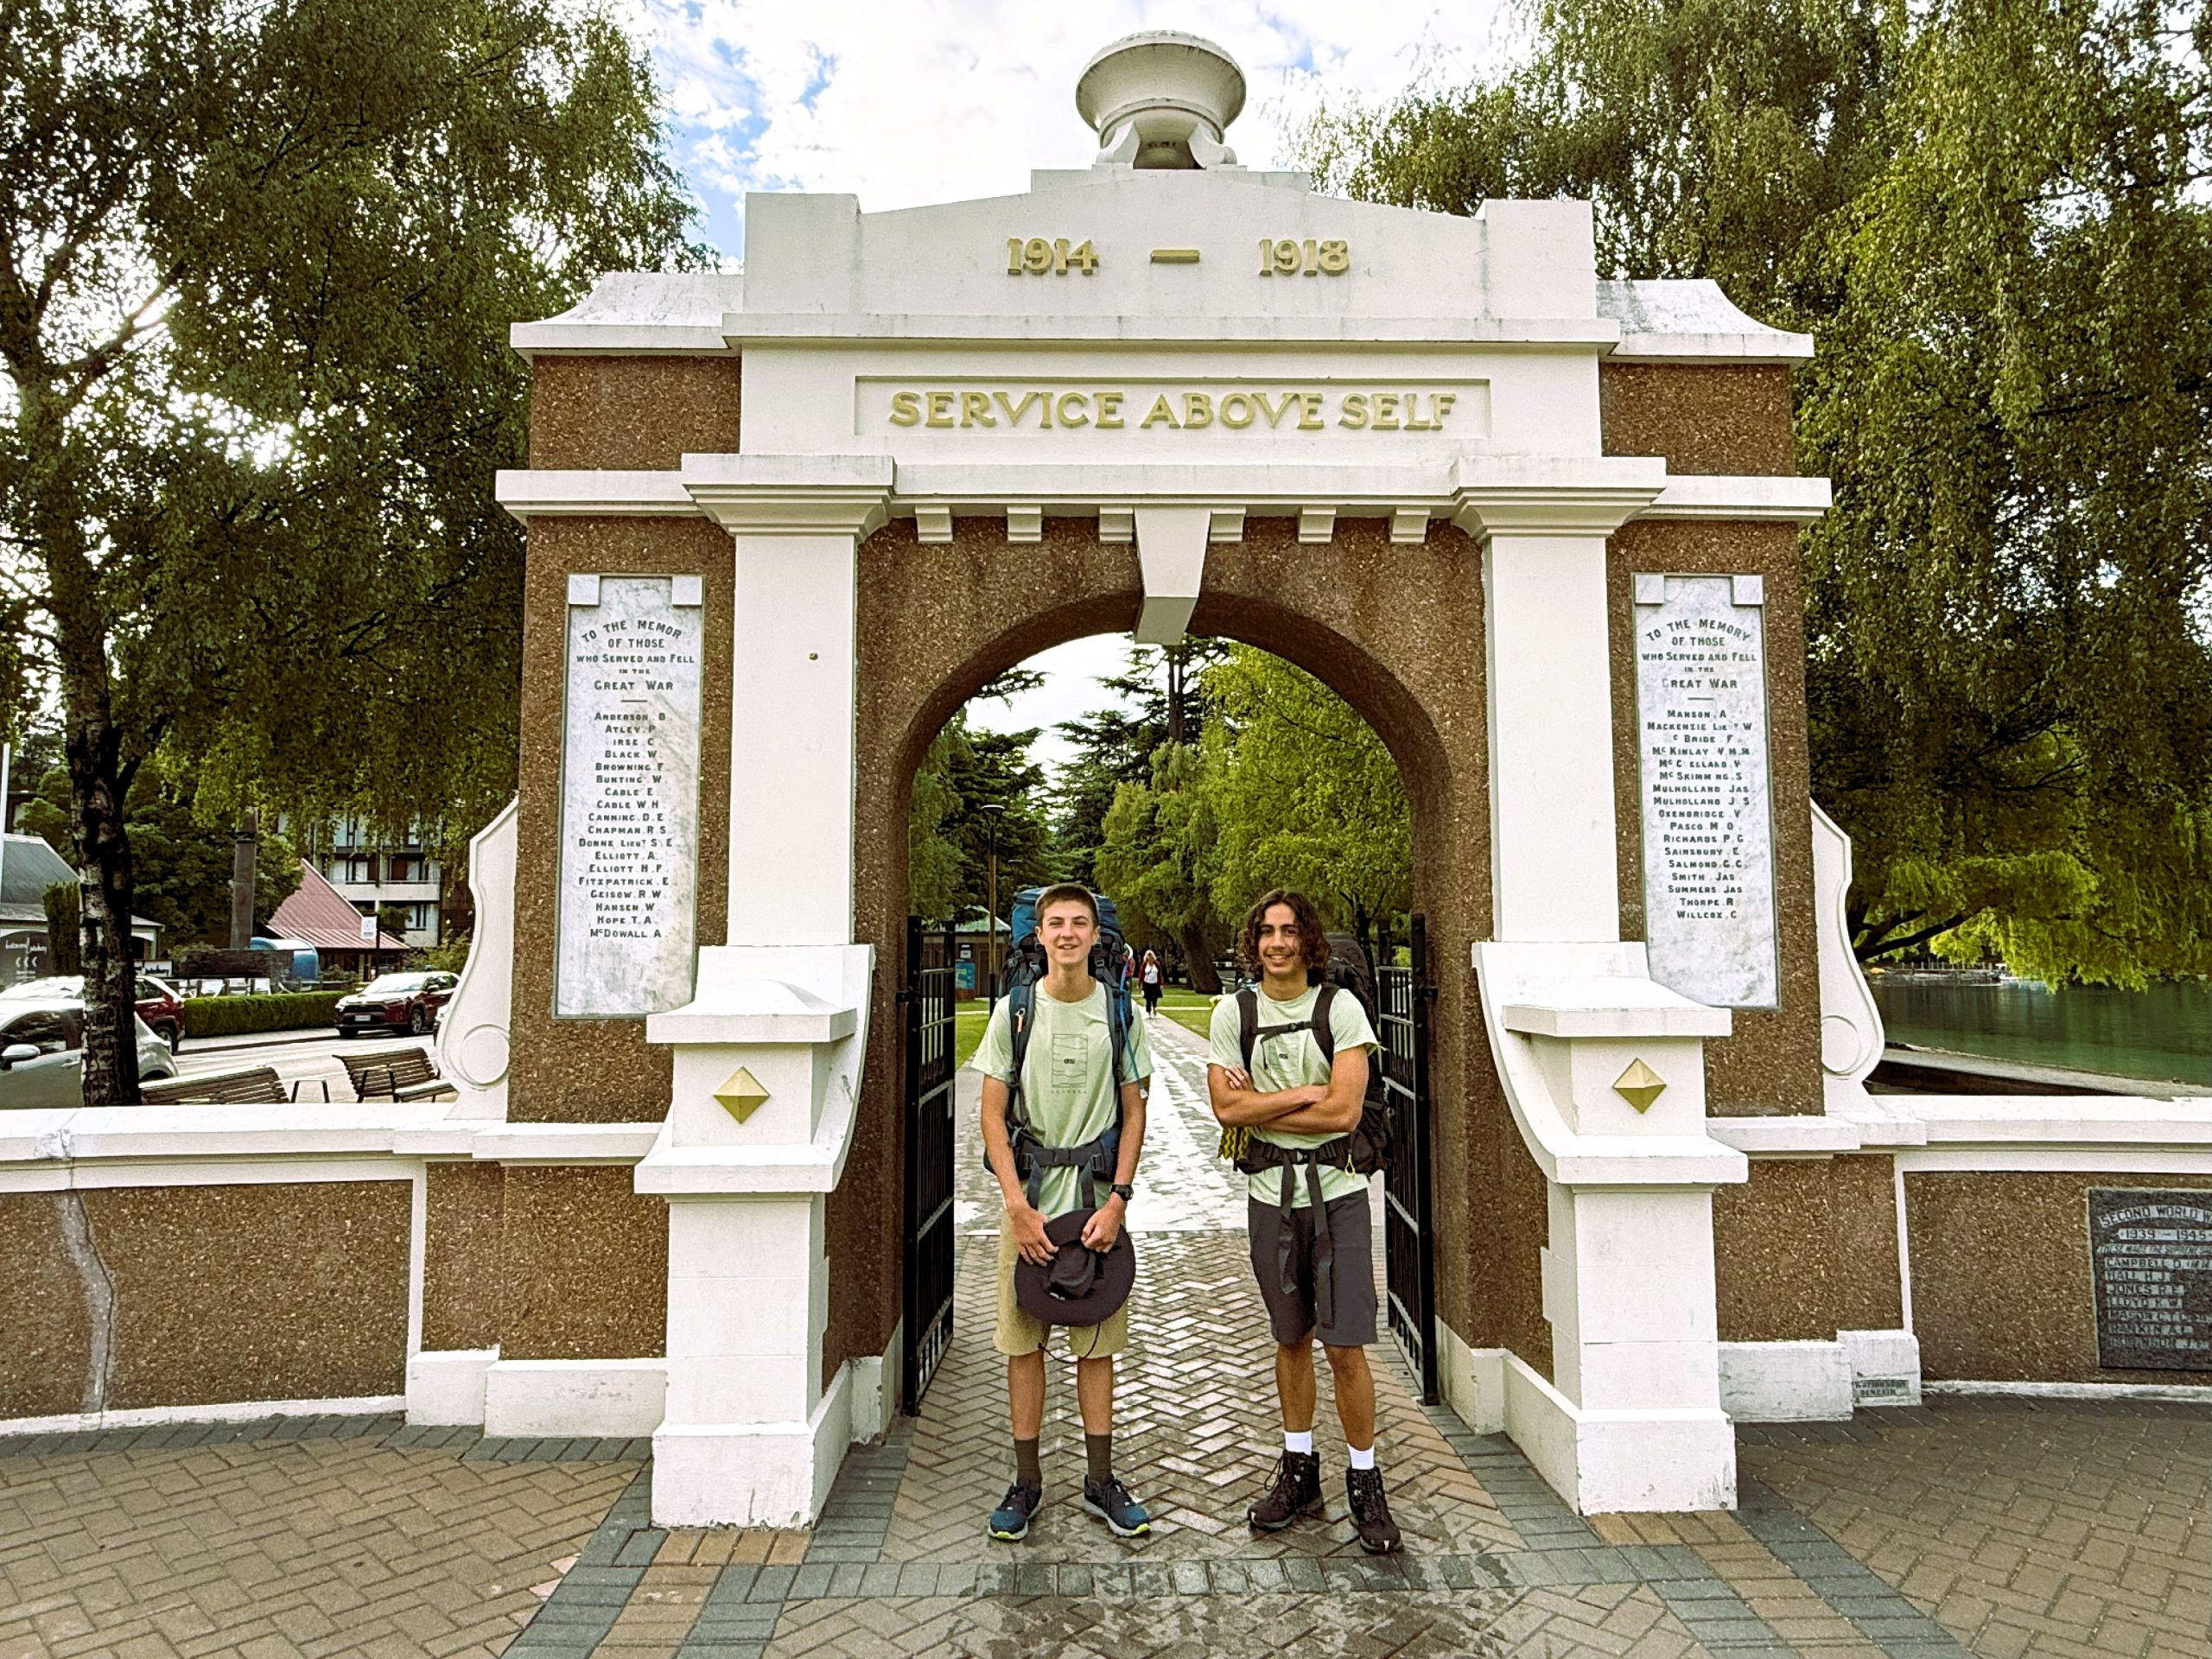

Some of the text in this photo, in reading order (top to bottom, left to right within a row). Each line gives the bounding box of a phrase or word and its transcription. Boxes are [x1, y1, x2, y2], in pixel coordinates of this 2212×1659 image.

[1007, 238, 1100, 276] 1914
[1259, 238, 1351, 277] 1918
[889, 391, 1457, 431] SERVICE ABOVE SELF
[581, 620, 686, 643] TO THE MEMOR
[1645, 619, 1751, 643] TO THE MEMORY
[607, 638, 664, 649] OF THOSE
[1671, 636, 1725, 647] OF THOSE
[576, 653, 695, 664] WHO SERVED AND FELL
[1642, 652, 1757, 662] WHO SERVED AND FELL
[594, 680, 674, 690] GREAT WAR
[1662, 677, 1738, 689] GREAT WAR
[594, 711, 649, 721] ANDERSON
[1667, 709, 1711, 719] MANSON
[1647, 721, 1707, 731] MACKENZIE
[605, 738, 639, 747] IRSE
[604, 749, 640, 759] BLACK
[594, 762, 652, 772] BROWNING
[595, 774, 643, 784] BUNTING
[1652, 784, 1749, 793] MULHOLLAND JAS
[1653, 796, 1720, 805] MULHOLLAND
[588, 812, 635, 822] CANNING
[1658, 809, 1725, 818] OXENBRIDGE
[588, 825, 641, 835] CHAPMAN
[1669, 822, 1703, 830] PASCO
[578, 837, 613, 848] DONNE
[1663, 834, 1718, 843] RICHARDS
[594, 850, 639, 861] ELLIOTT
[1664, 847, 1723, 856] SAINSBURY
[588, 863, 633, 873] ELLIOTT
[1669, 859, 1718, 868] SALMOND
[578, 876, 653, 886] FITZPATRICK
[1671, 872, 1735, 881] SMITH JAS
[1668, 884, 1743, 893] SUMMERS JAS
[1679, 897, 1719, 906] THORPE
[595, 902, 639, 912] HANSEN
[1676, 910, 1723, 919] WILLCOX
[597, 915, 626, 925] HOPE
[2099, 1206, 2152, 1227] SECOND
[2156, 1205, 2199, 1219] WORLD
[2126, 1229, 2156, 1239] 1939
[2177, 1230, 2207, 1240] 1945
[2107, 1258, 2168, 1268] CAMPBELL
[2108, 1284, 2152, 1294] JONES
